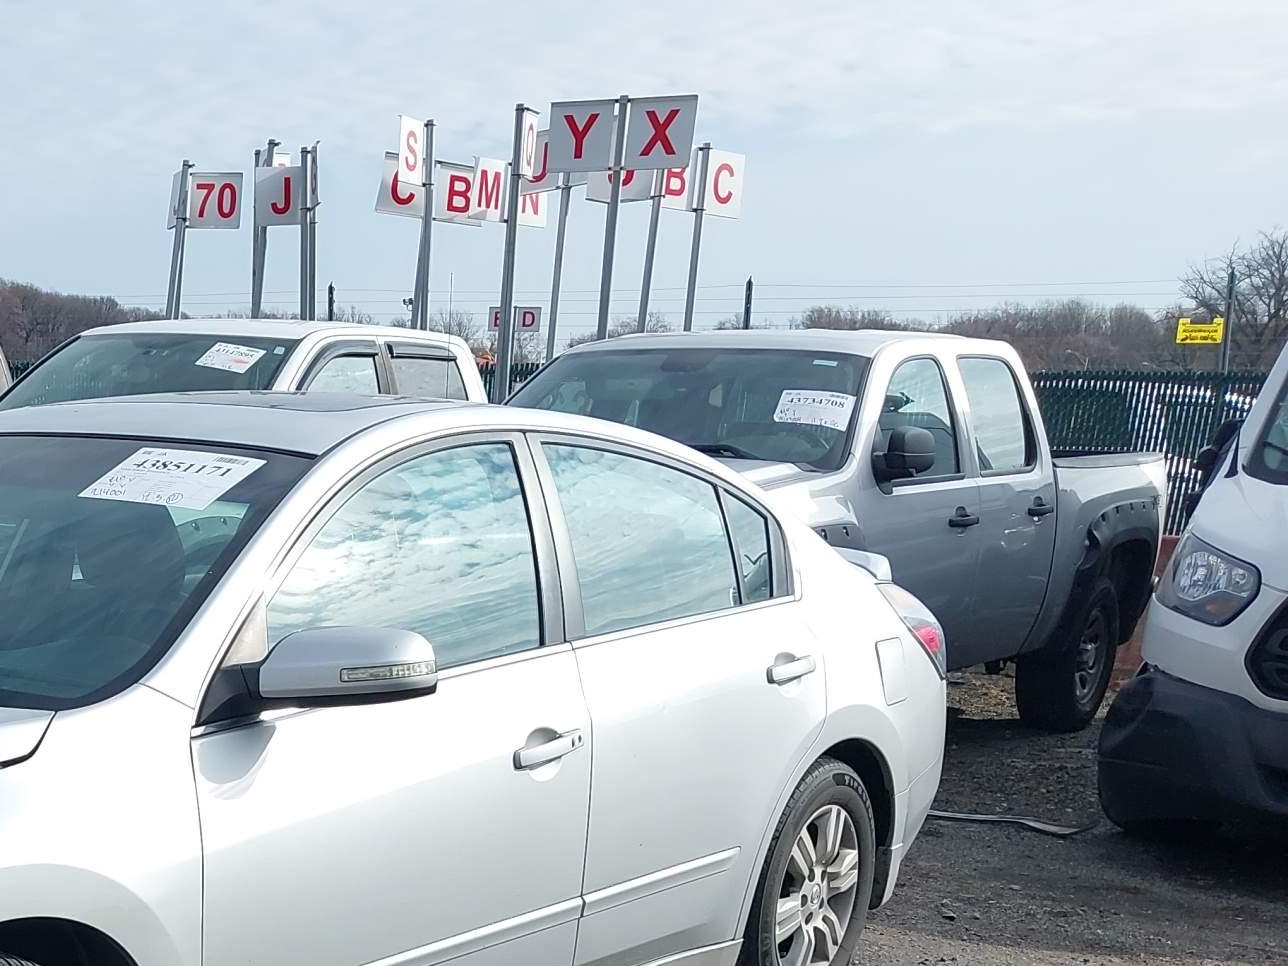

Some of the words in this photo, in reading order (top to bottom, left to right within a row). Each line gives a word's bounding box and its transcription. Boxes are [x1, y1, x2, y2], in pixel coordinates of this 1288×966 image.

[405, 130, 418, 171] S
[563, 112, 600, 159] Y
[639, 109, 681, 157] X
[196, 182, 237, 219] 70
[270, 176, 291, 215] J
[447, 174, 471, 213] B
[477, 169, 501, 210] M
[713, 163, 735, 205] C
[521, 310, 536, 328] D
[786, 396, 846, 408] 43734708
[132, 458, 233, 477] 43851171
